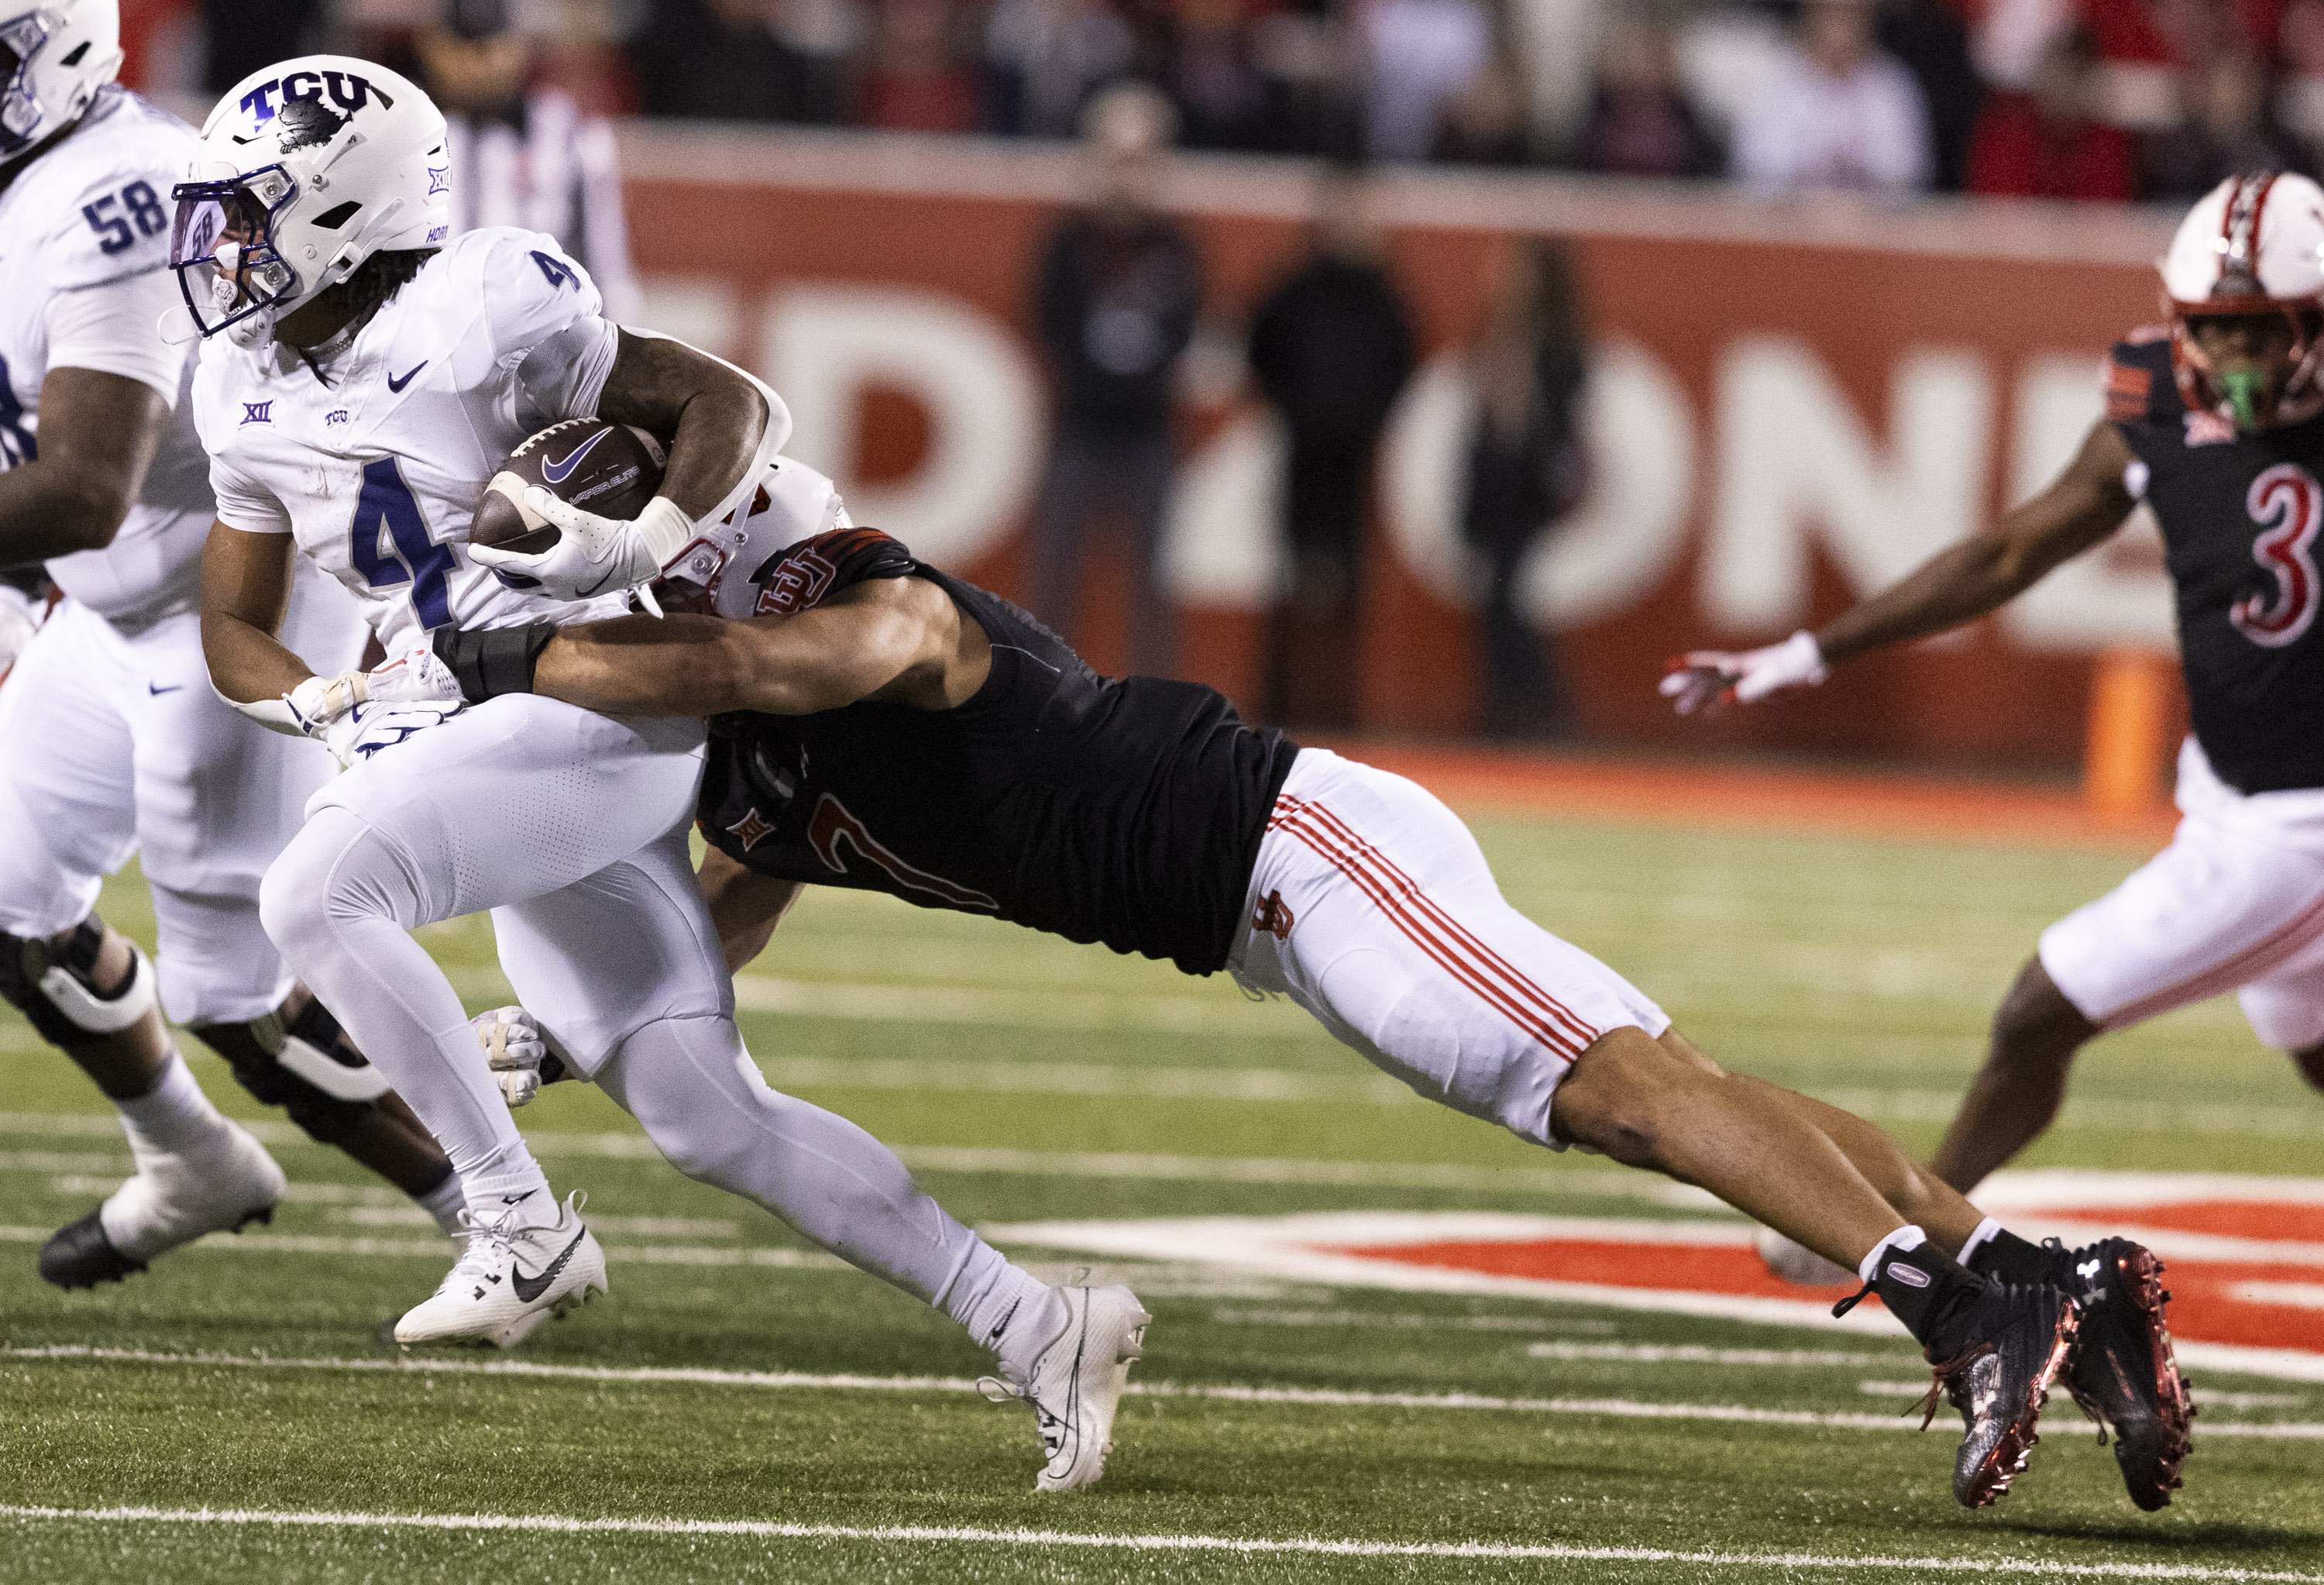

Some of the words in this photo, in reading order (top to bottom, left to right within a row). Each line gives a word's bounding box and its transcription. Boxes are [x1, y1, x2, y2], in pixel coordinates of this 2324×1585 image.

[240, 70, 371, 133] TCU
[82, 181, 167, 256] 58
[530, 249, 581, 292] 4
[325, 410, 348, 426] TCU
[569, 481, 612, 506] VAPOR
[610, 465, 641, 487] ELITE
[349, 456, 462, 635] 4
[2230, 463, 2324, 648] 3
[807, 792, 1000, 910] 7
